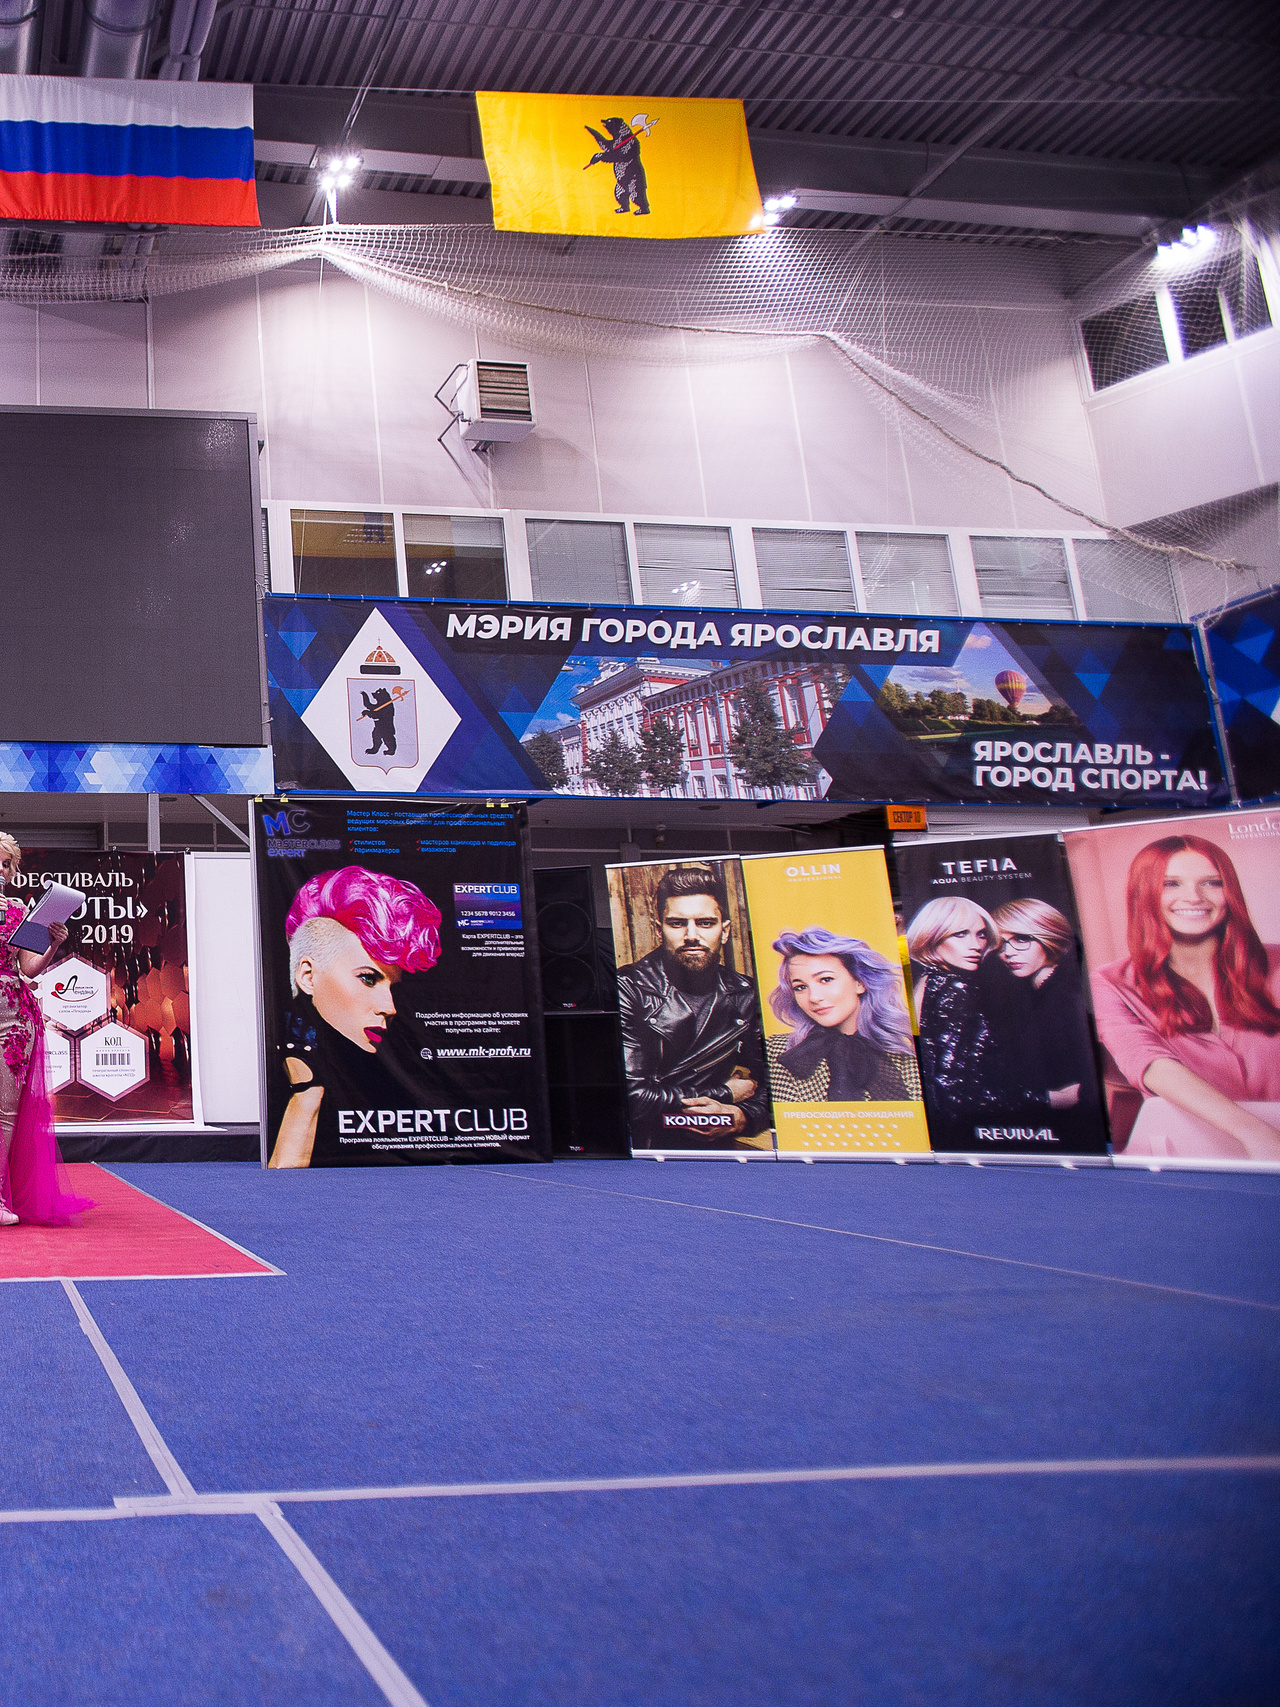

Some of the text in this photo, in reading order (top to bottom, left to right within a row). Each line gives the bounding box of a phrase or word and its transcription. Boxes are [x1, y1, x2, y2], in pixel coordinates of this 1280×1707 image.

[446, 614, 939, 653] МЭРИЯ ГОРОДА ЯРОСЛАВЛЯ
[974, 741, 1153, 765] ЯРОСЛАВЛЬ
[975, 765, 1209, 792] ГОРОД СПОРТА!
[347, 810, 370, 818] Мастер
[429, 811, 488, 819] профессиональных
[893, 810, 921, 823] СЕКТОР 10
[785, 863, 841, 877] OLLIN
[941, 858, 1017, 875] TEFIA
[961, 875, 994, 883] BEAUTY
[81, 924, 134, 944] 2019
[436, 1046, 531, 1058] www.mk-profy.ru
[665, 1115, 732, 1126] KONDOR
[783, 1111, 914, 1119] ПРЕВОСХОДИТЬ ОЖИДАНИЯ
[977, 1128, 1060, 1141] REVIVAL
[372, 1143, 414, 1151] обслуживания
